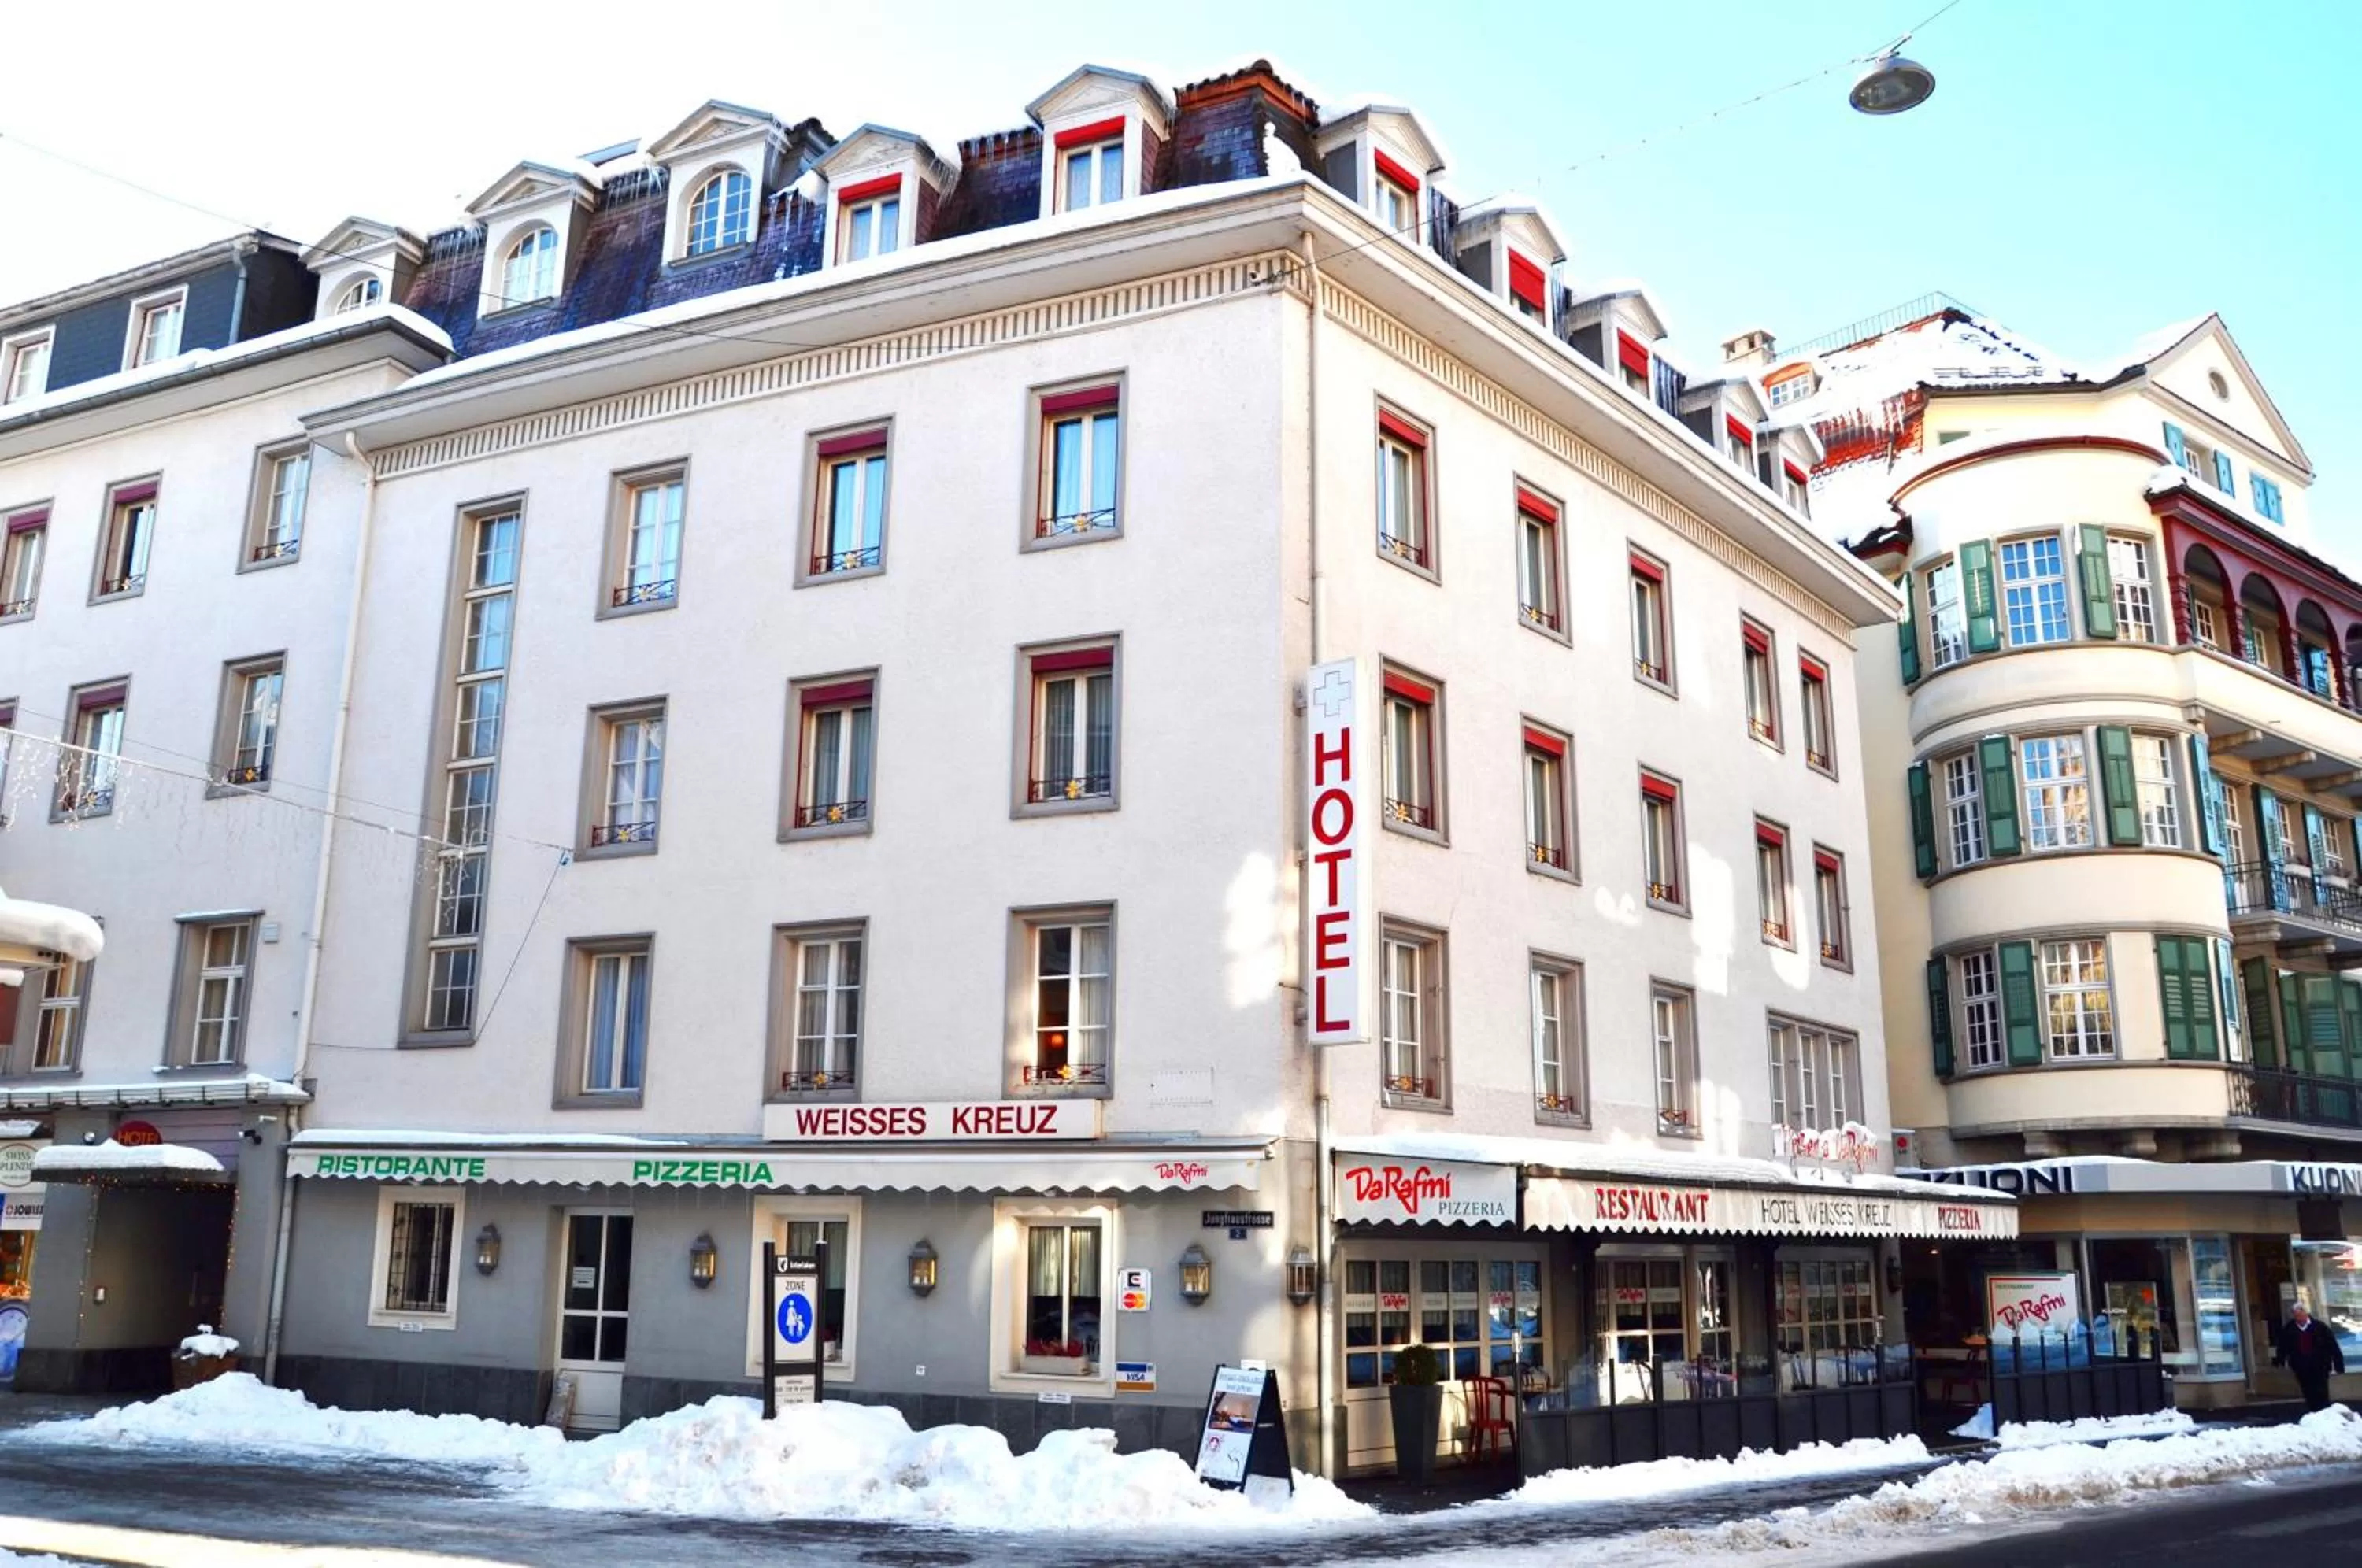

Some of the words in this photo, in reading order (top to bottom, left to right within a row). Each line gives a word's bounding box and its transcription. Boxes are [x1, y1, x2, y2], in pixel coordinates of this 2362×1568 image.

[1312, 727, 1353, 1033] HOTEL
[796, 1107, 927, 1135] WEISSES
[952, 1105, 1058, 1134] KREUZ
[118, 1131, 160, 1145] HOTE
[317, 1155, 485, 1177] RISTORANTE
[633, 1161, 774, 1183] PIZZERIA
[1438, 1201, 1505, 1216] PIZZERIA
[1594, 1187, 1709, 1222] RESTAURANT
[1761, 1199, 1801, 1225] HOTEL
[1807, 1200, 1854, 1226] WEISSES
[1857, 1204, 1891, 1227] KREUZ
[1938, 1206, 1981, 1230] PIZZERIA
[785, 1281, 805, 1291] ZONE
[1126, 1373, 1146, 1381] VISA
